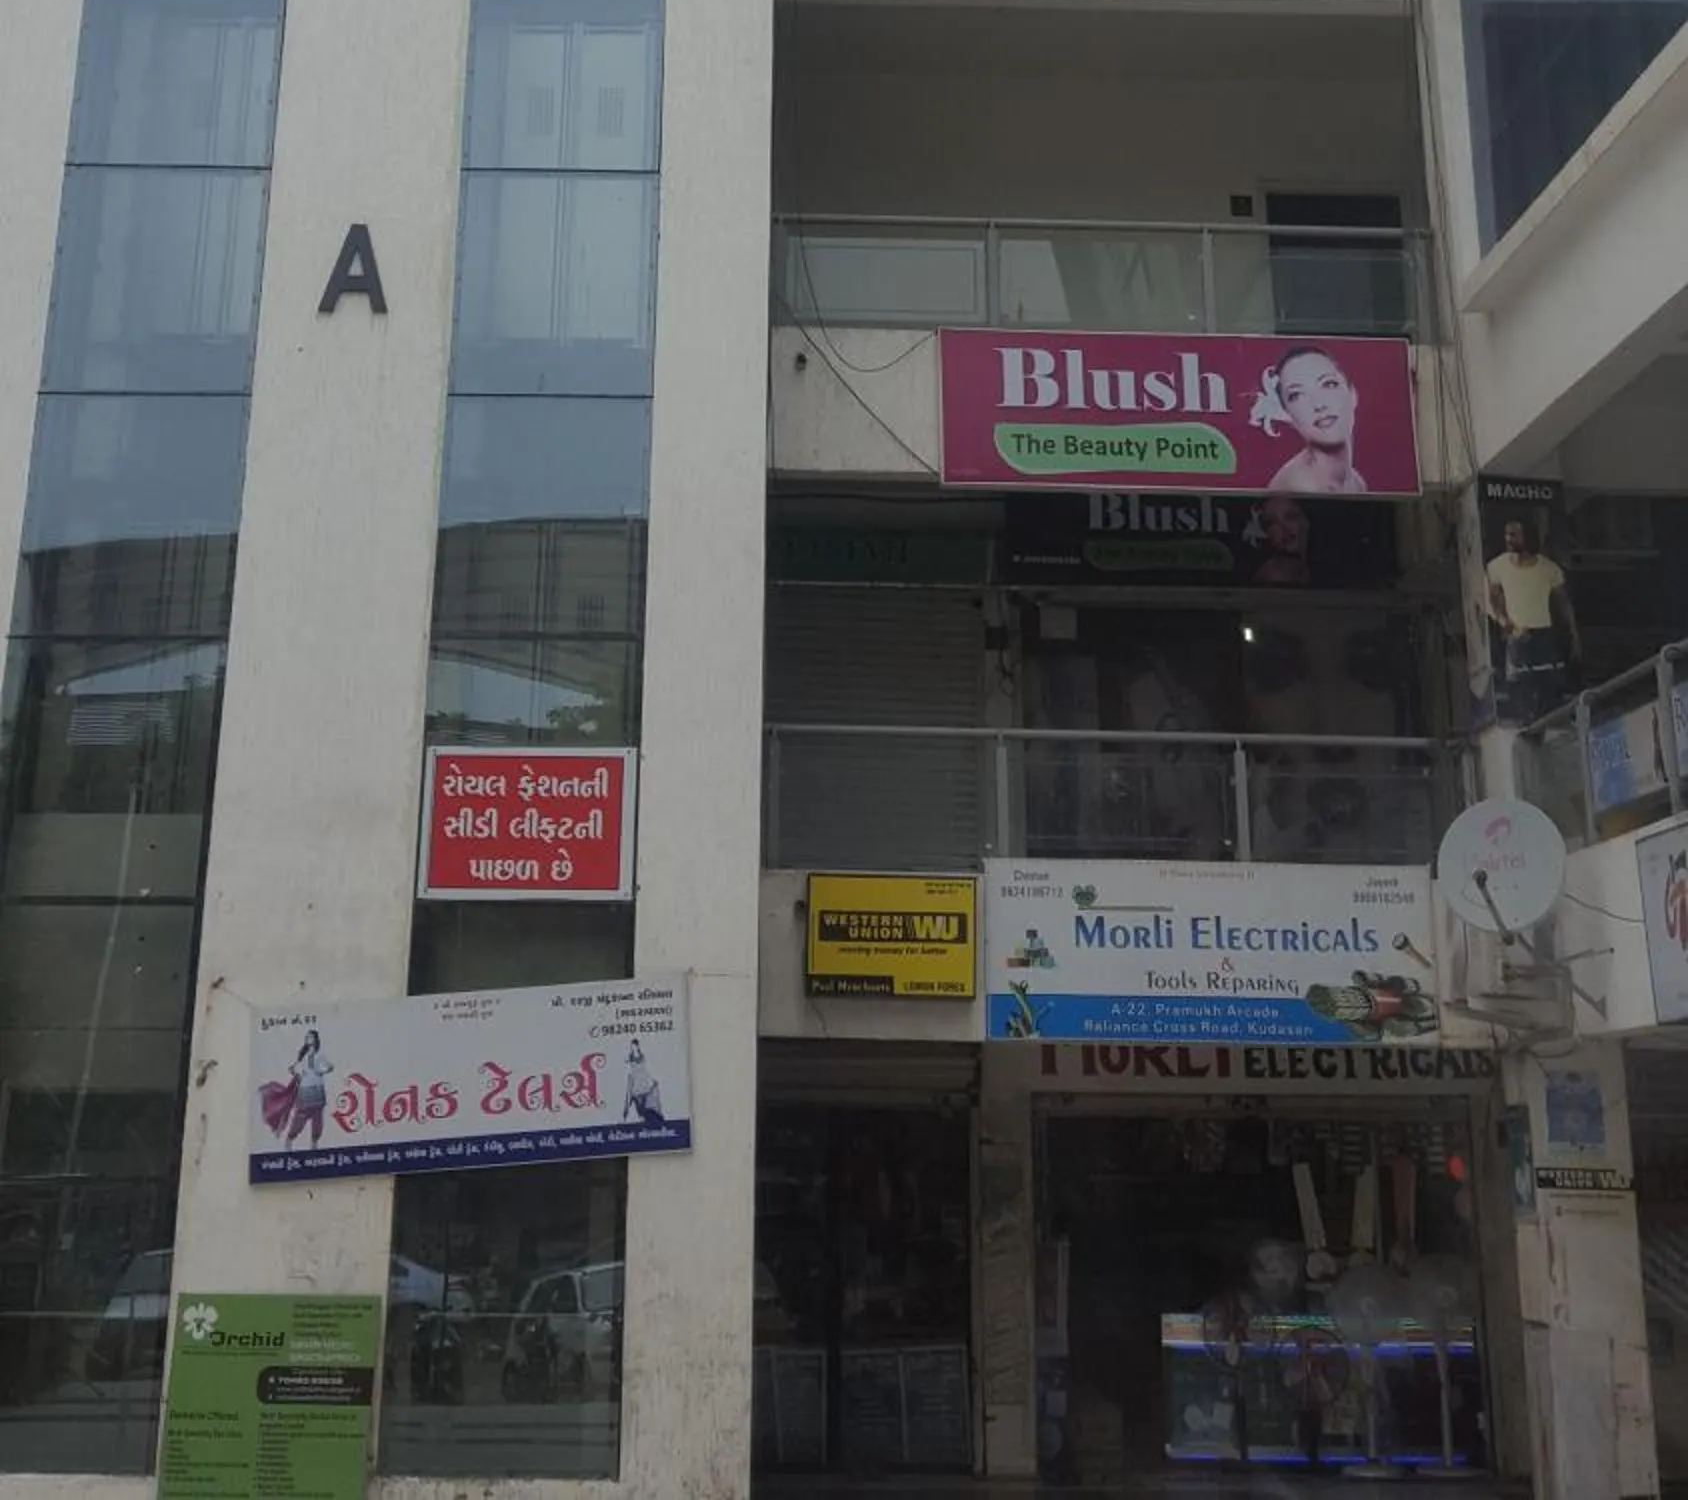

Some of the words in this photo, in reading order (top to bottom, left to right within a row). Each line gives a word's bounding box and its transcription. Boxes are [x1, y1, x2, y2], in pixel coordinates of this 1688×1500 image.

[318, 223, 389, 315] A
[993, 346, 1232, 415] Blush
[1010, 432, 1059, 457] The
[1063, 435, 1148, 463] Beauty
[1155, 436, 1219, 461] Point
[1088, 492, 1231, 533] Blush
[442, 763, 507, 797] રોયલ
[517, 764, 609, 801] ફેશનની
[443, 807, 498, 838] સીડી
[469, 858, 540, 881] પાછળ
[551, 847, 574, 881] છે
[823, 913, 904, 927] WESTERN
[848, 927, 904, 938] UNION
[1146, 970, 1197, 989] Tools
[331, 1073, 460, 1134] રોનક
[479, 1052, 607, 1117] ટેલર્સ
